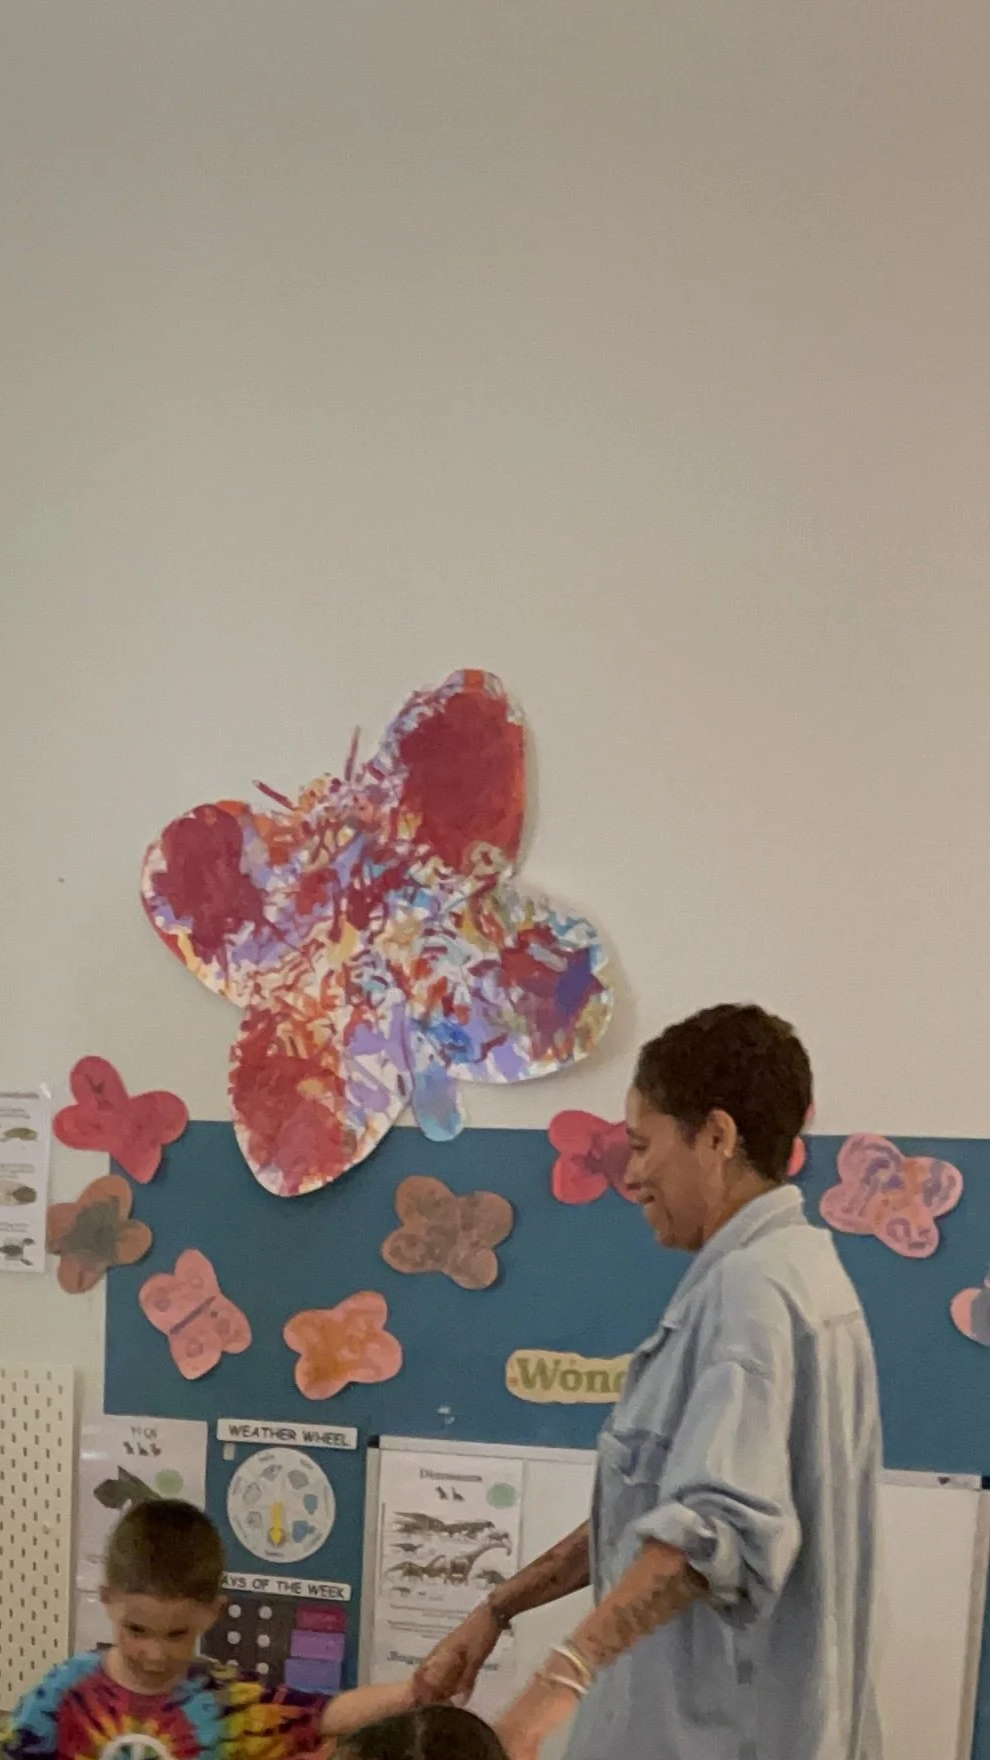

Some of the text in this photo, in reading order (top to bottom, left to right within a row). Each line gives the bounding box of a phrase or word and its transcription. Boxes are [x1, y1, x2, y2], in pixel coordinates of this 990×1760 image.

[228, 1424, 350, 1447] WEATHER WHEEL
[223, 1575, 345, 1599] AYS OF THE WEEK
